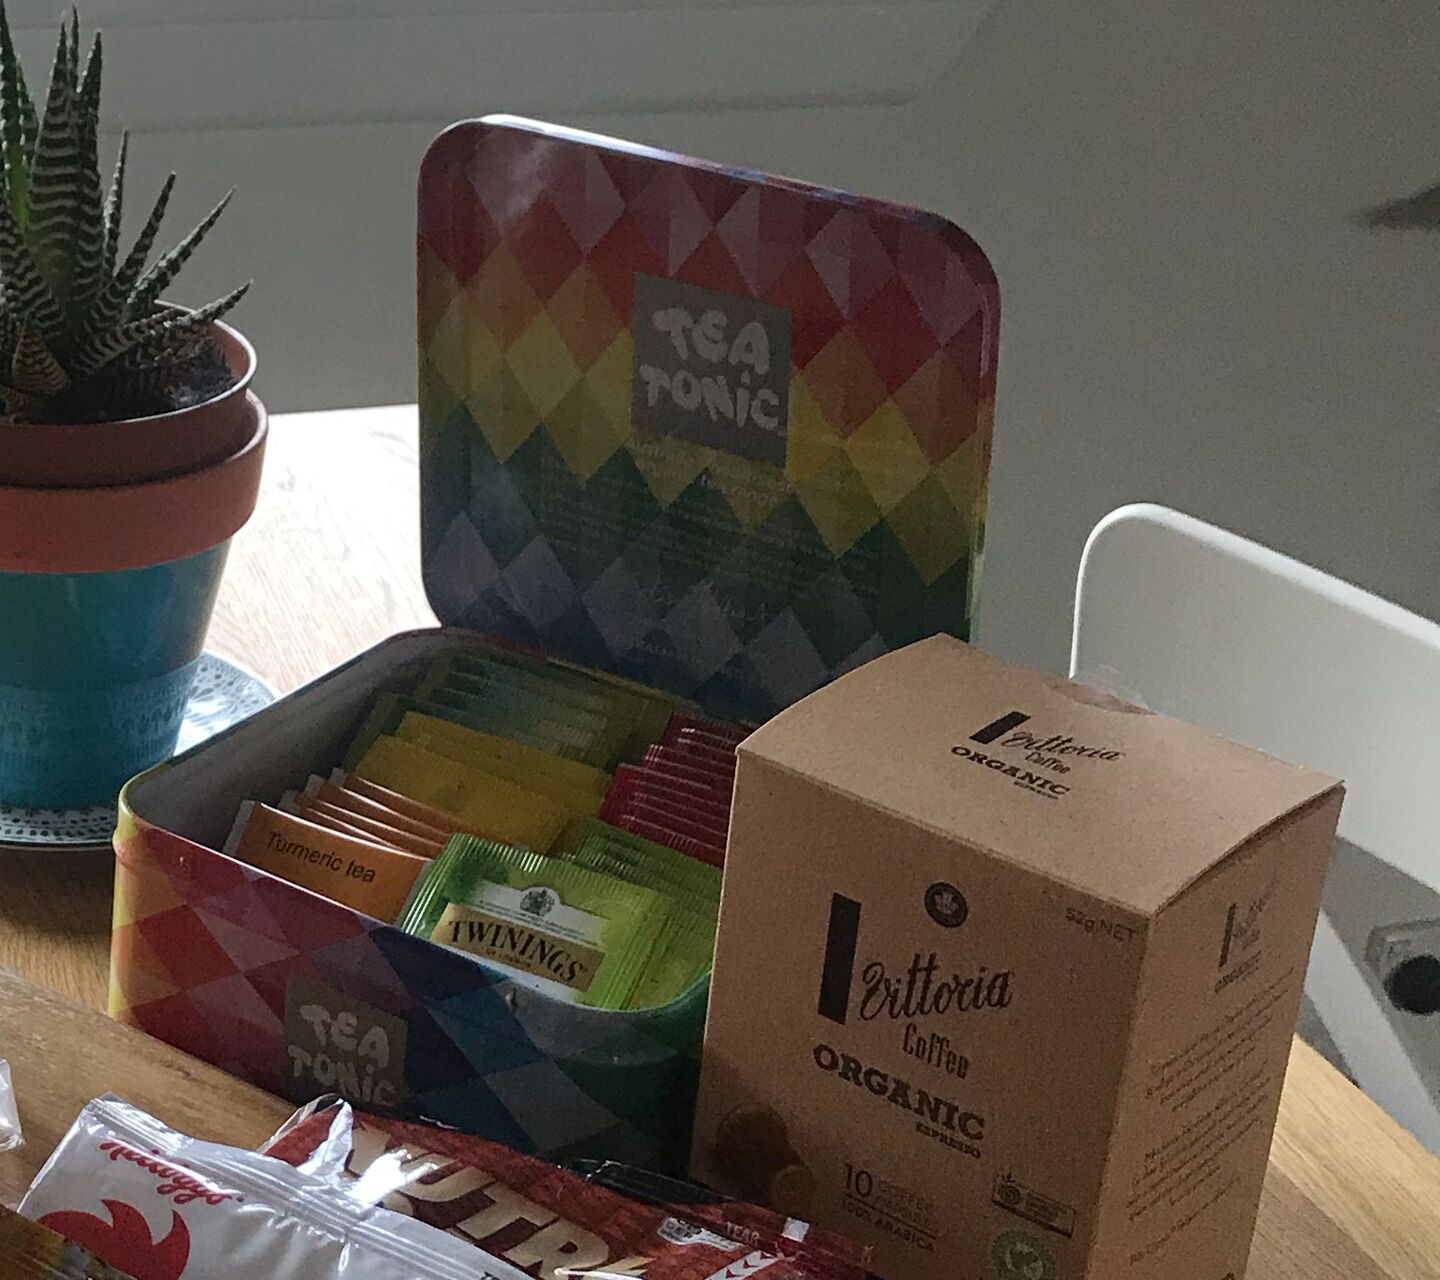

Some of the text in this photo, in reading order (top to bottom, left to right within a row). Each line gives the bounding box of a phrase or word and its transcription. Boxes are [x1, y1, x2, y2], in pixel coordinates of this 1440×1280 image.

[652, 306, 770, 375] TEA
[950, 746, 1072, 795] ORGANIC
[264, 830, 377, 885] Turmeric tea
[448, 919, 585, 983] TWININGS
[299, 1003, 390, 1069] TEA
[903, 1022, 971, 1080] Coffee
[813, 1044, 985, 1141] ORGANIC
[844, 1163, 874, 1198] 10
